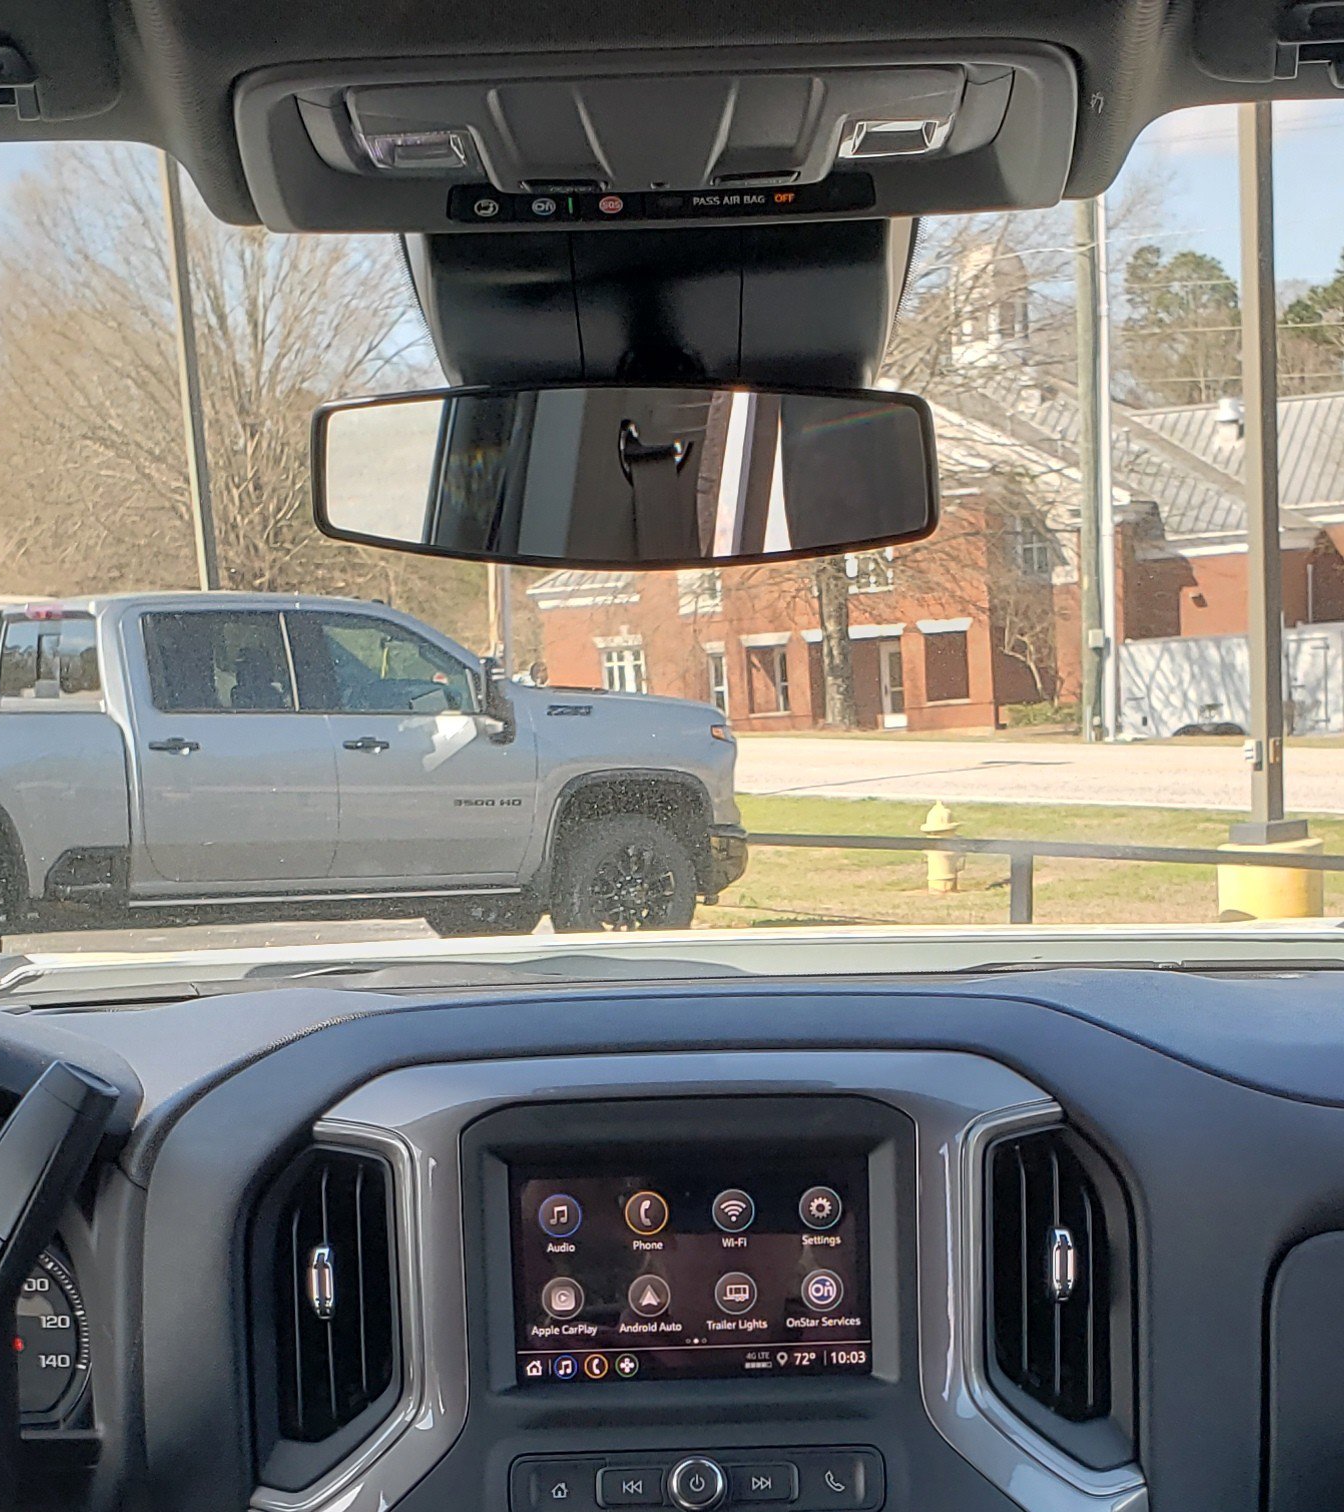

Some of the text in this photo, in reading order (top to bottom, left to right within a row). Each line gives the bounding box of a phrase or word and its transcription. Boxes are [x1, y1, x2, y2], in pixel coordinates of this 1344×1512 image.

[692, 193, 795, 206] PASS AIR BAG OFF
[500, 798, 522, 807] HD
[632, 1239, 664, 1251] Phone
[720, 1236, 748, 1248] Wi-Fi
[801, 1234, 842, 1247] Settings
[546, 1242, 576, 1254] Audio
[24, 1278, 50, 1292] 00
[39, 1315, 71, 1329] 120
[619, 1321, 683, 1333] Android Auto
[706, 1317, 768, 1331] Trailer Lights
[786, 1315, 862, 1329] OnStar Services
[531, 1323, 599, 1338] Apple CarPlay
[38, 1354, 71, 1368] 140
[745, 1350, 771, 1361] 4G LTE
[830, 1350, 867, 1365] 10:03
